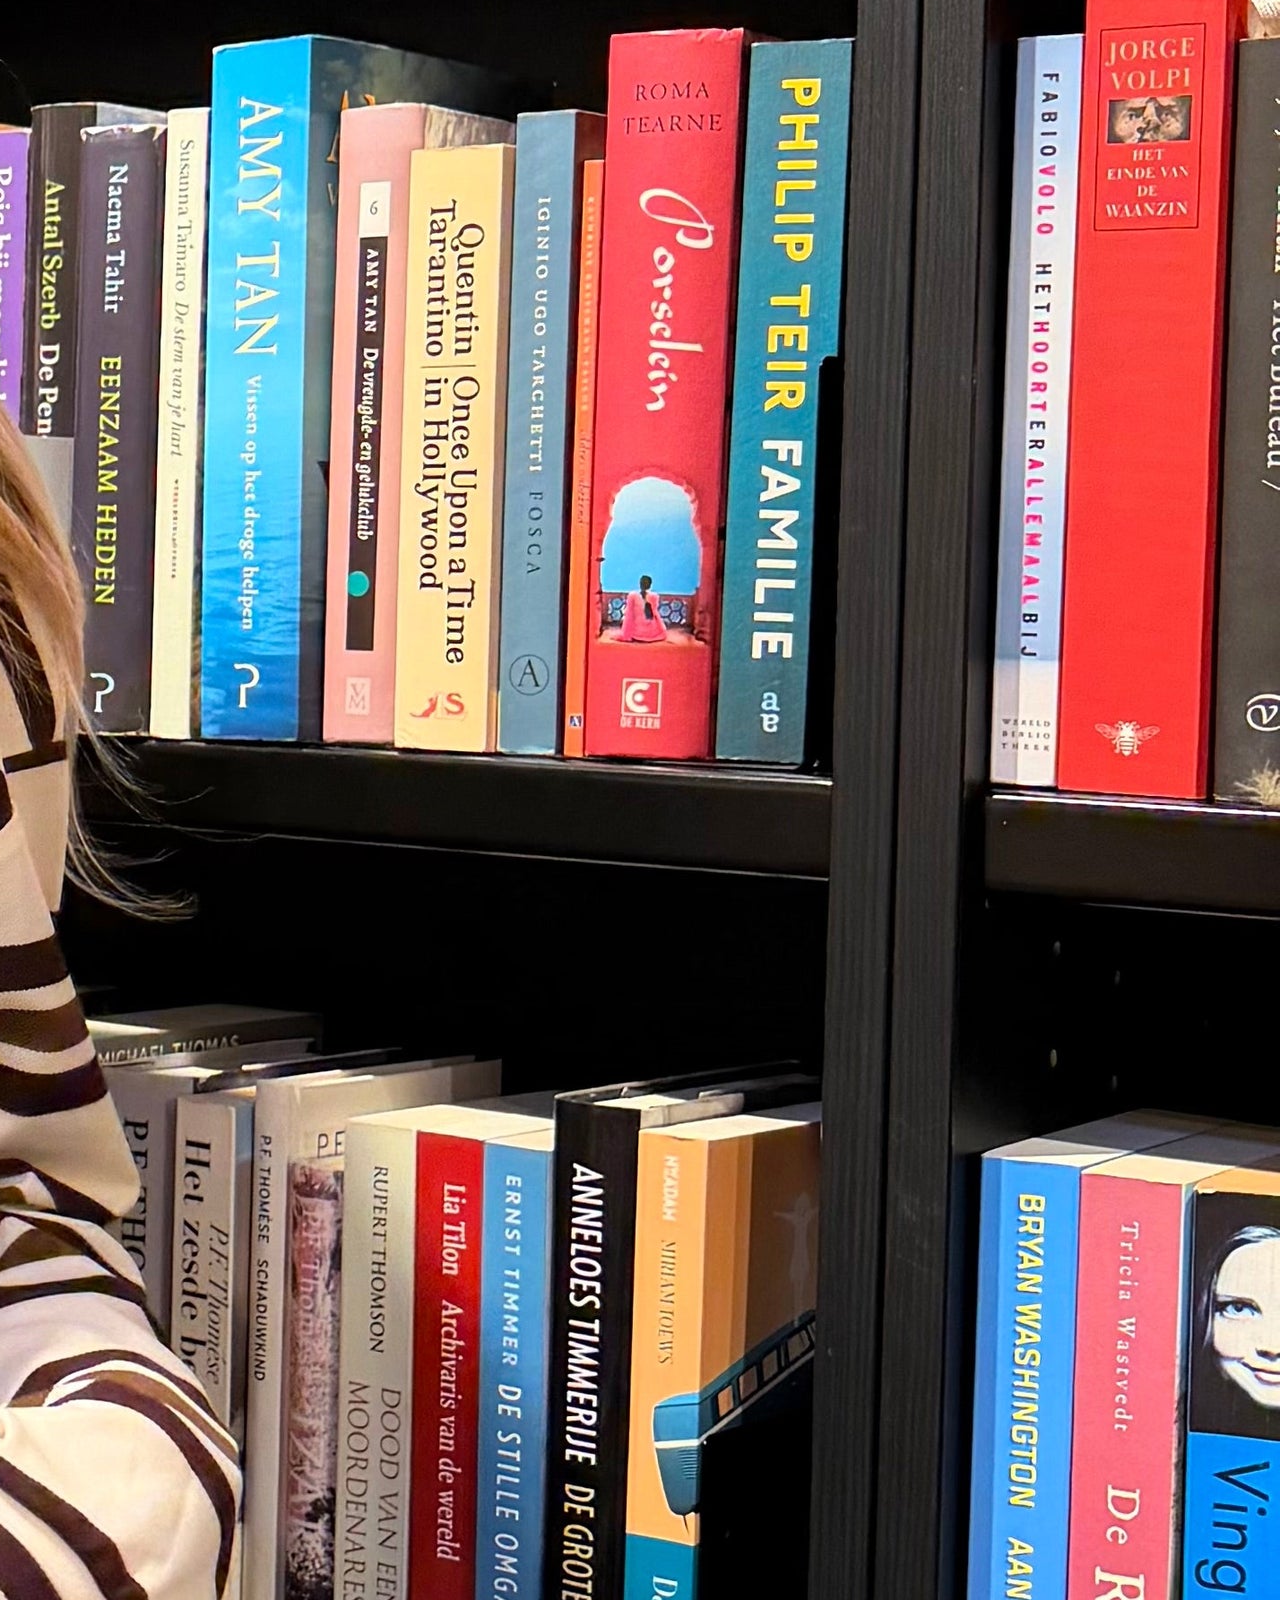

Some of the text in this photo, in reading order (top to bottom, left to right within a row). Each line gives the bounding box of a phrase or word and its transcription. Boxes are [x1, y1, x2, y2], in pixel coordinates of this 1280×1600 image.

[635, 81, 710, 101] ROMA
[1104, 37, 1197, 67] JORGE
[1109, 67, 1193, 94] VOLPI
[623, 114, 724, 135] TEARNE
[1132, 148, 1166, 162] HET
[1104, 198, 1190, 220] WAANZIN
[1106, 164, 1190, 182] EINDE VAN
[1137, 184, 1158, 198] DE
[38, 178, 66, 381] Antal Szerb De
[638, 188, 716, 412] Porselein
[93, 163, 129, 605] Naema Tahir EENZAAM HEDEN
[233, 96, 286, 631] AMY TAN Vissen op het droge helpen
[415, 199, 459, 591] Tarantino in Hollywood
[751, 77, 822, 661] PHILIP TEIR FAMILIE
[445, 223, 486, 666] Quentin Once Upon a Time
[179, 1137, 212, 1322] Het zesde
[370, 1165, 389, 1244] RUPERT
[503, 1174, 522, 1254] ERNST
[569, 1163, 604, 1309] ANNELOES
[1014, 1193, 1046, 1296] BRYAN
[368, 1248, 387, 1354] THOMSON
[501, 1268, 521, 1366] TIMMER
[434, 1183, 467, 1561] Lia Tilon Archivaris van de wereld
[497, 1384, 521, 1418] DE
[564, 1318, 600, 1467] TIMMERIJE
[1008, 1302, 1043, 1508] WASHINGTON
[378, 1387, 402, 1480] DOOD
[494, 1430, 520, 1520] STILLE
[376, 1492, 399, 1552] VAN
[563, 1484, 596, 1519] DE
[1103, 1486, 1141, 1546] De
